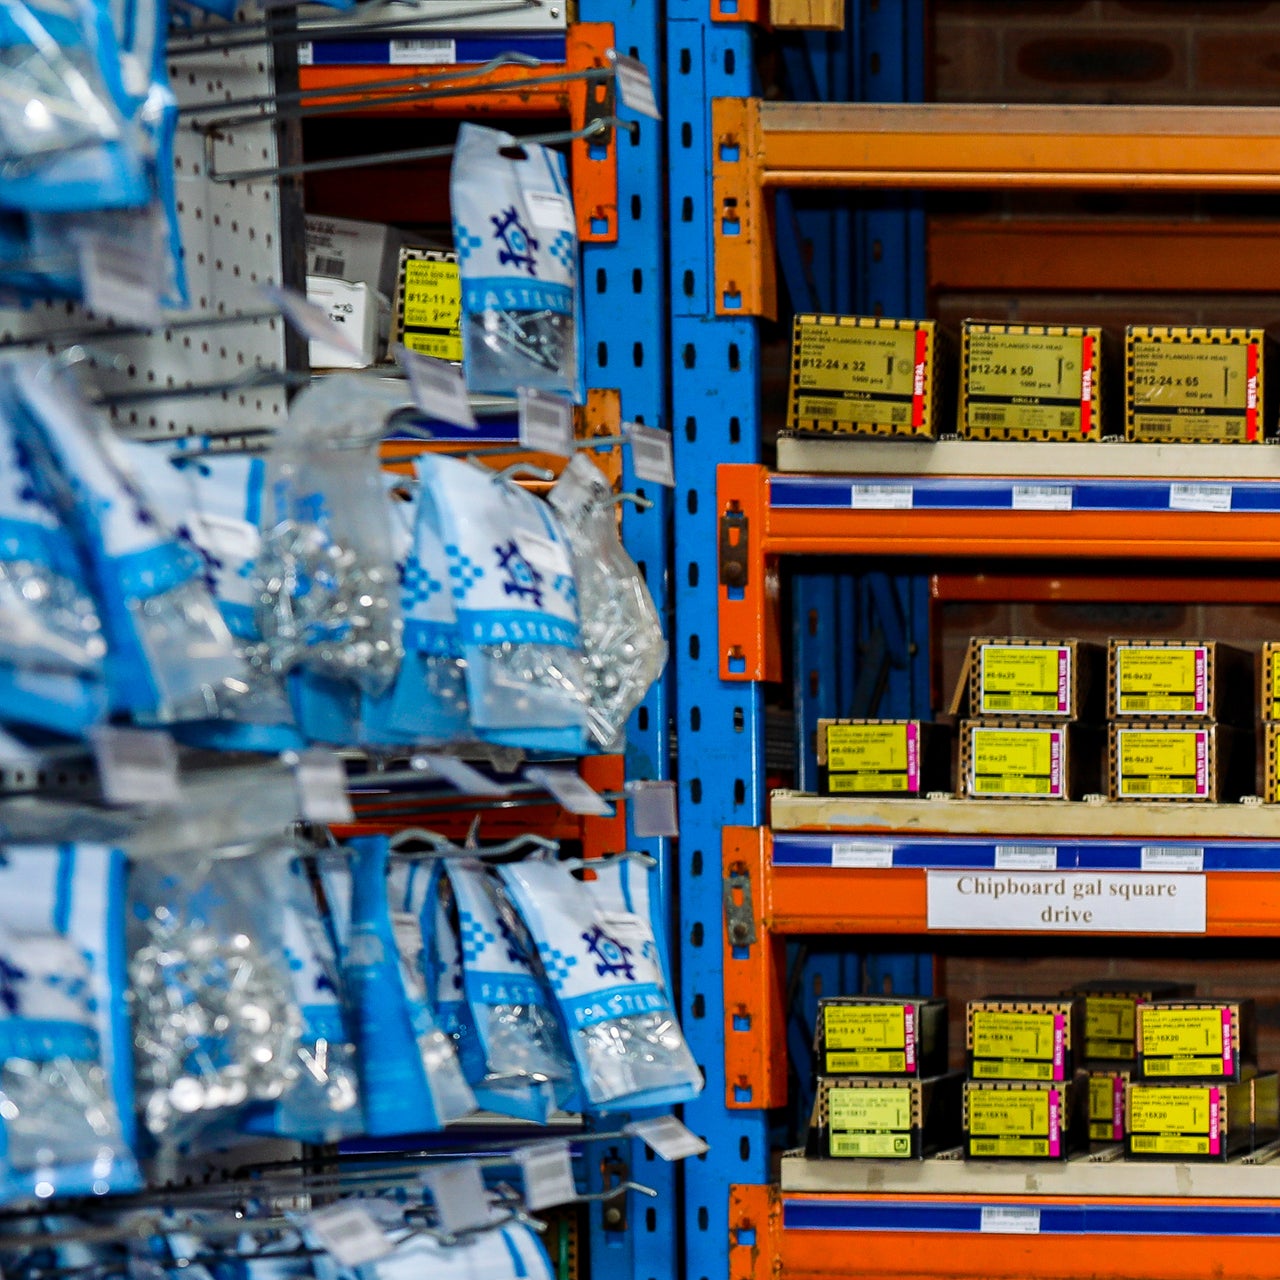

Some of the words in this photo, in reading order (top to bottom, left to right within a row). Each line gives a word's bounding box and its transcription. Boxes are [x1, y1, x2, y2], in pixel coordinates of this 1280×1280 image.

[408, 292, 446, 305] #12-11
[802, 358, 840, 370] #12-24
[852, 361, 866, 371] 32
[971, 365, 1009, 375] #12-24
[914, 362, 925, 396] METAL
[1082, 368, 1091, 401] METAL
[1136, 376, 1174, 386] #12-24
[1185, 377, 1199, 387] 65
[1248, 376, 1256, 409] METAL
[957, 877, 1066, 899] Chipboard
[1073, 880, 1102, 900] gal
[1109, 881, 1177, 901] square
[1041, 905, 1093, 923] drive
